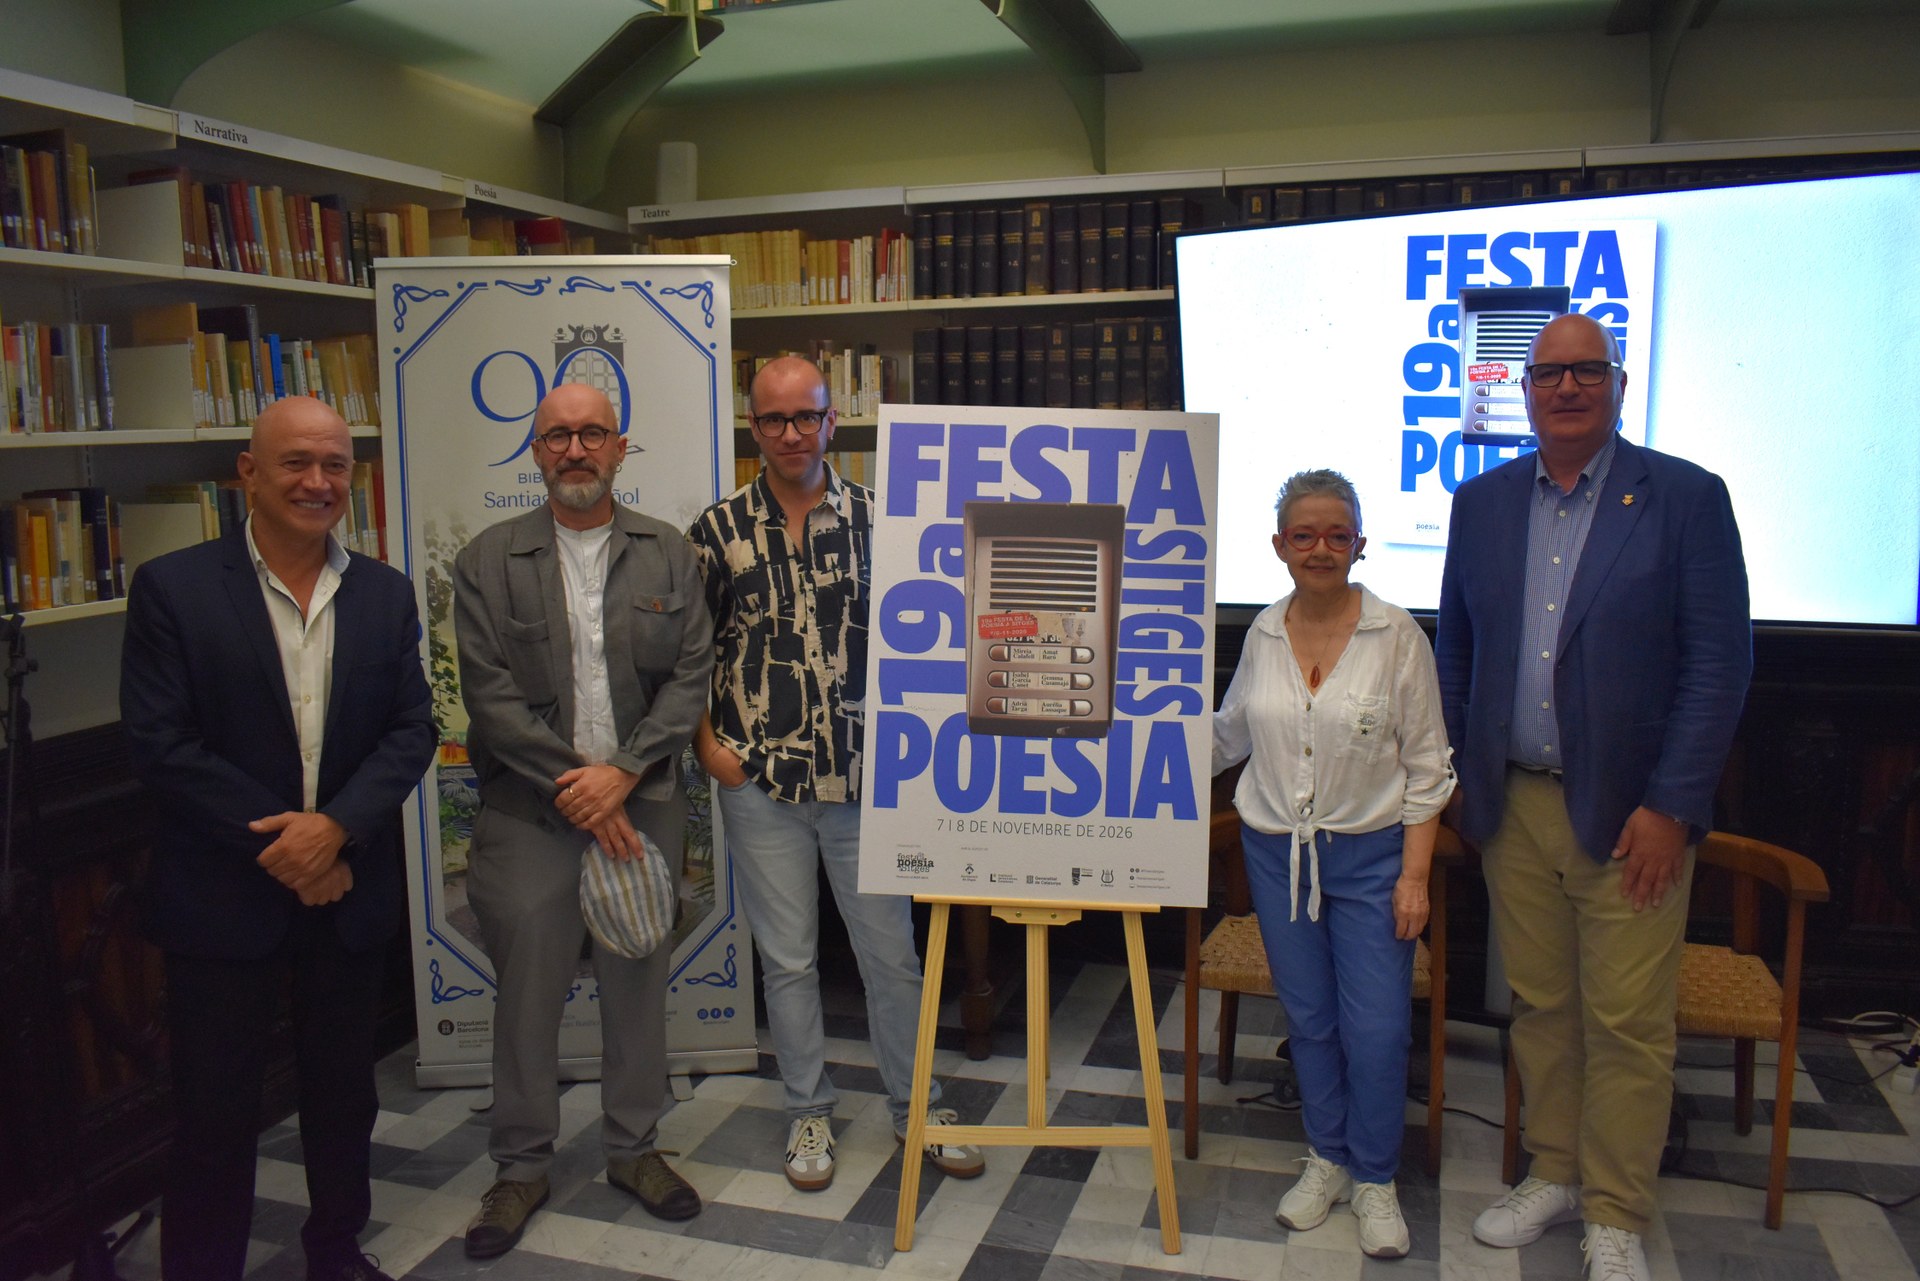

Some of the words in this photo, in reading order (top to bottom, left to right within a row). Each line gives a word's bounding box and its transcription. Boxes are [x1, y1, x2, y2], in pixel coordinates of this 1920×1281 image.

[194, 119, 249, 145] Narrativa
[474, 183, 497, 199] Poesia
[641, 207, 671, 218] Teatre
[1405, 229, 1629, 300] FESTA
[886, 422, 1207, 527] FESTA
[484, 490, 548, 509] Santia
[1114, 529, 1208, 717] SITGES
[873, 710, 1199, 821] POESIA
[937, 818, 944, 832] 7
[948, 820, 952, 832] I
[956, 819, 965, 832] 8
[970, 820, 988, 834] DE
[992, 821, 1072, 836] NOVEMBRE
[1076, 824, 1095, 838] DE
[1099, 825, 1133, 839] 2026
[896, 858, 935, 868] poesia
